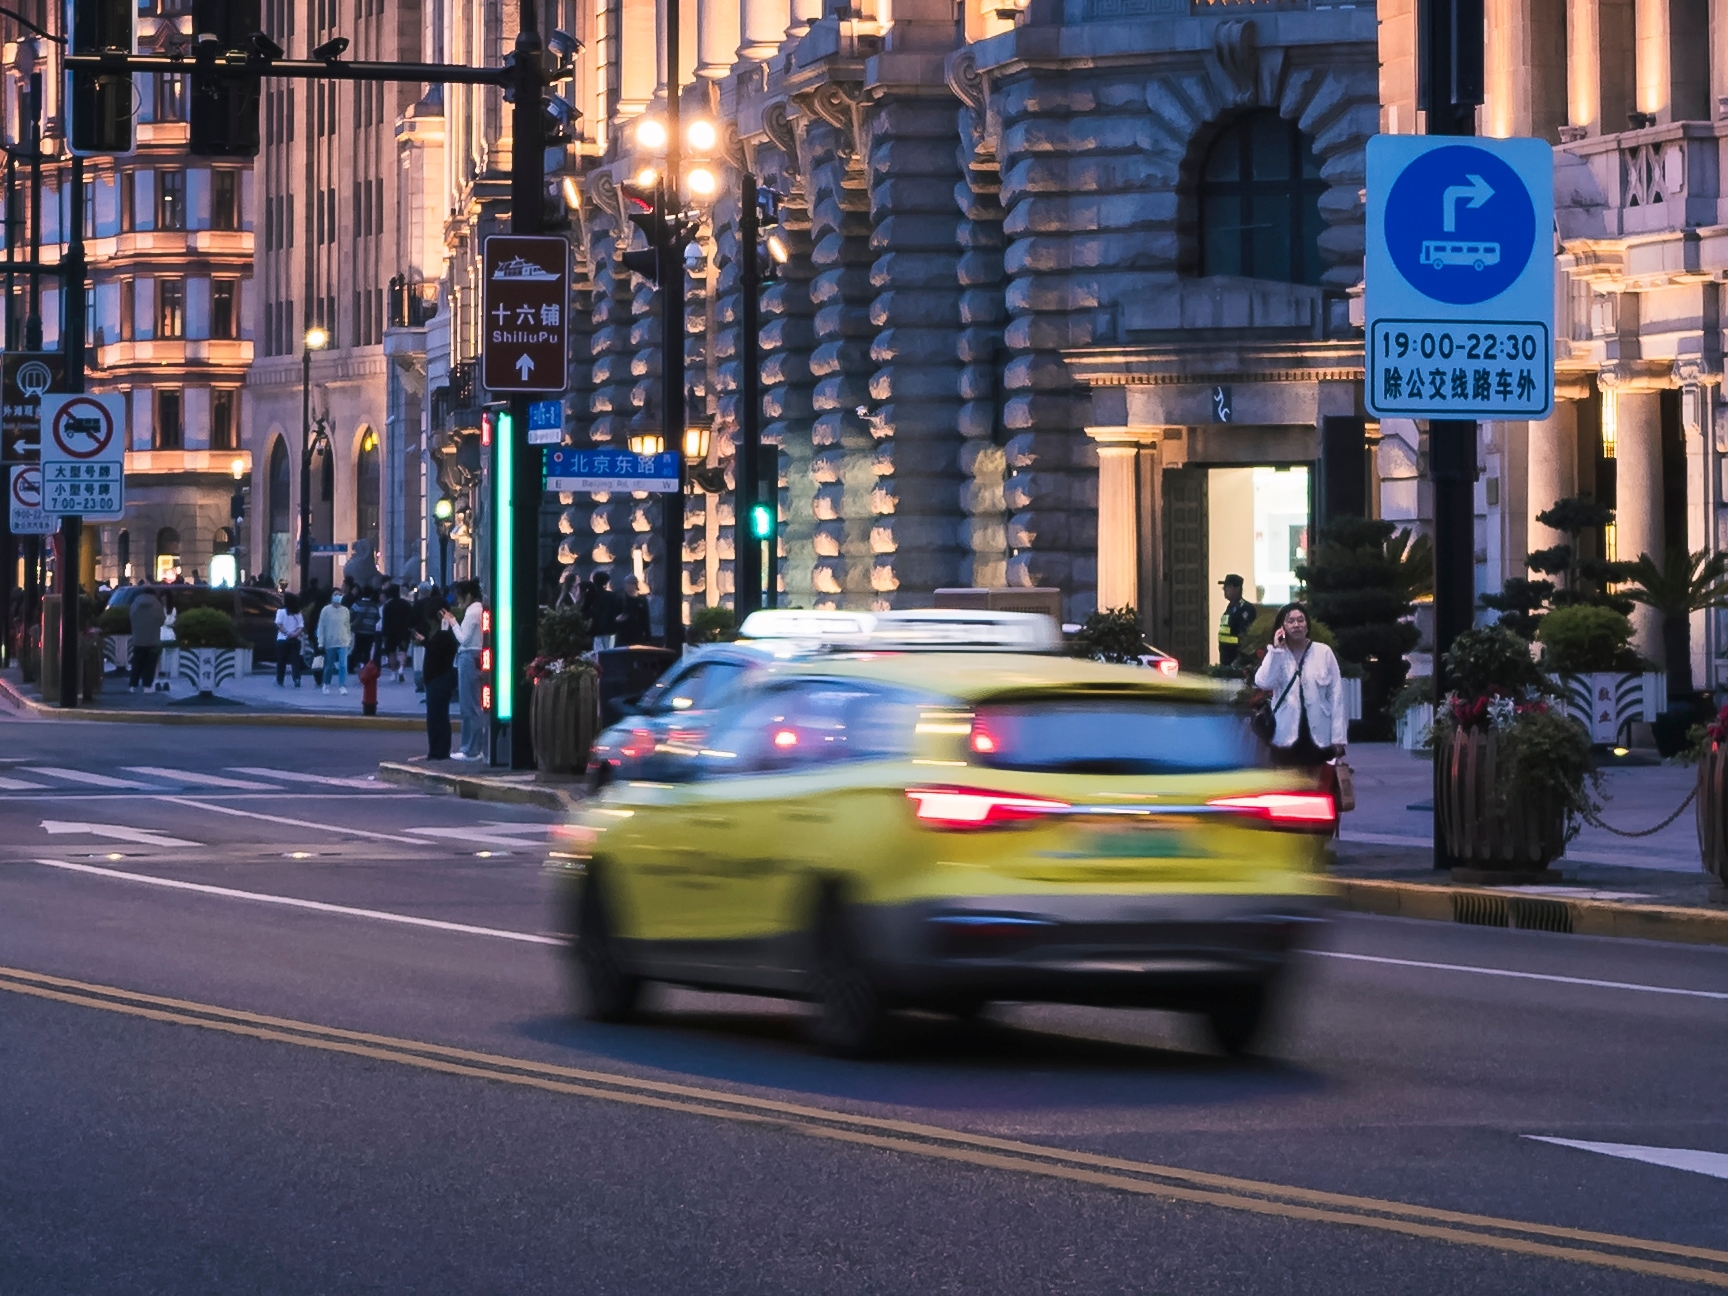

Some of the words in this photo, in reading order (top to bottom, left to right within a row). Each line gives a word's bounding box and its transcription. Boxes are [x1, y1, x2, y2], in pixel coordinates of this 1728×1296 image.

[491, 302, 560, 326] 十六铺
[1382, 331, 1537, 361] 19:00-22:30
[1383, 366, 1537, 403] 除公交线路车外
[55, 465, 111, 478] 大型号牌
[570, 453, 655, 475] 北京东路
[54, 483, 111, 496] 小型号牌
